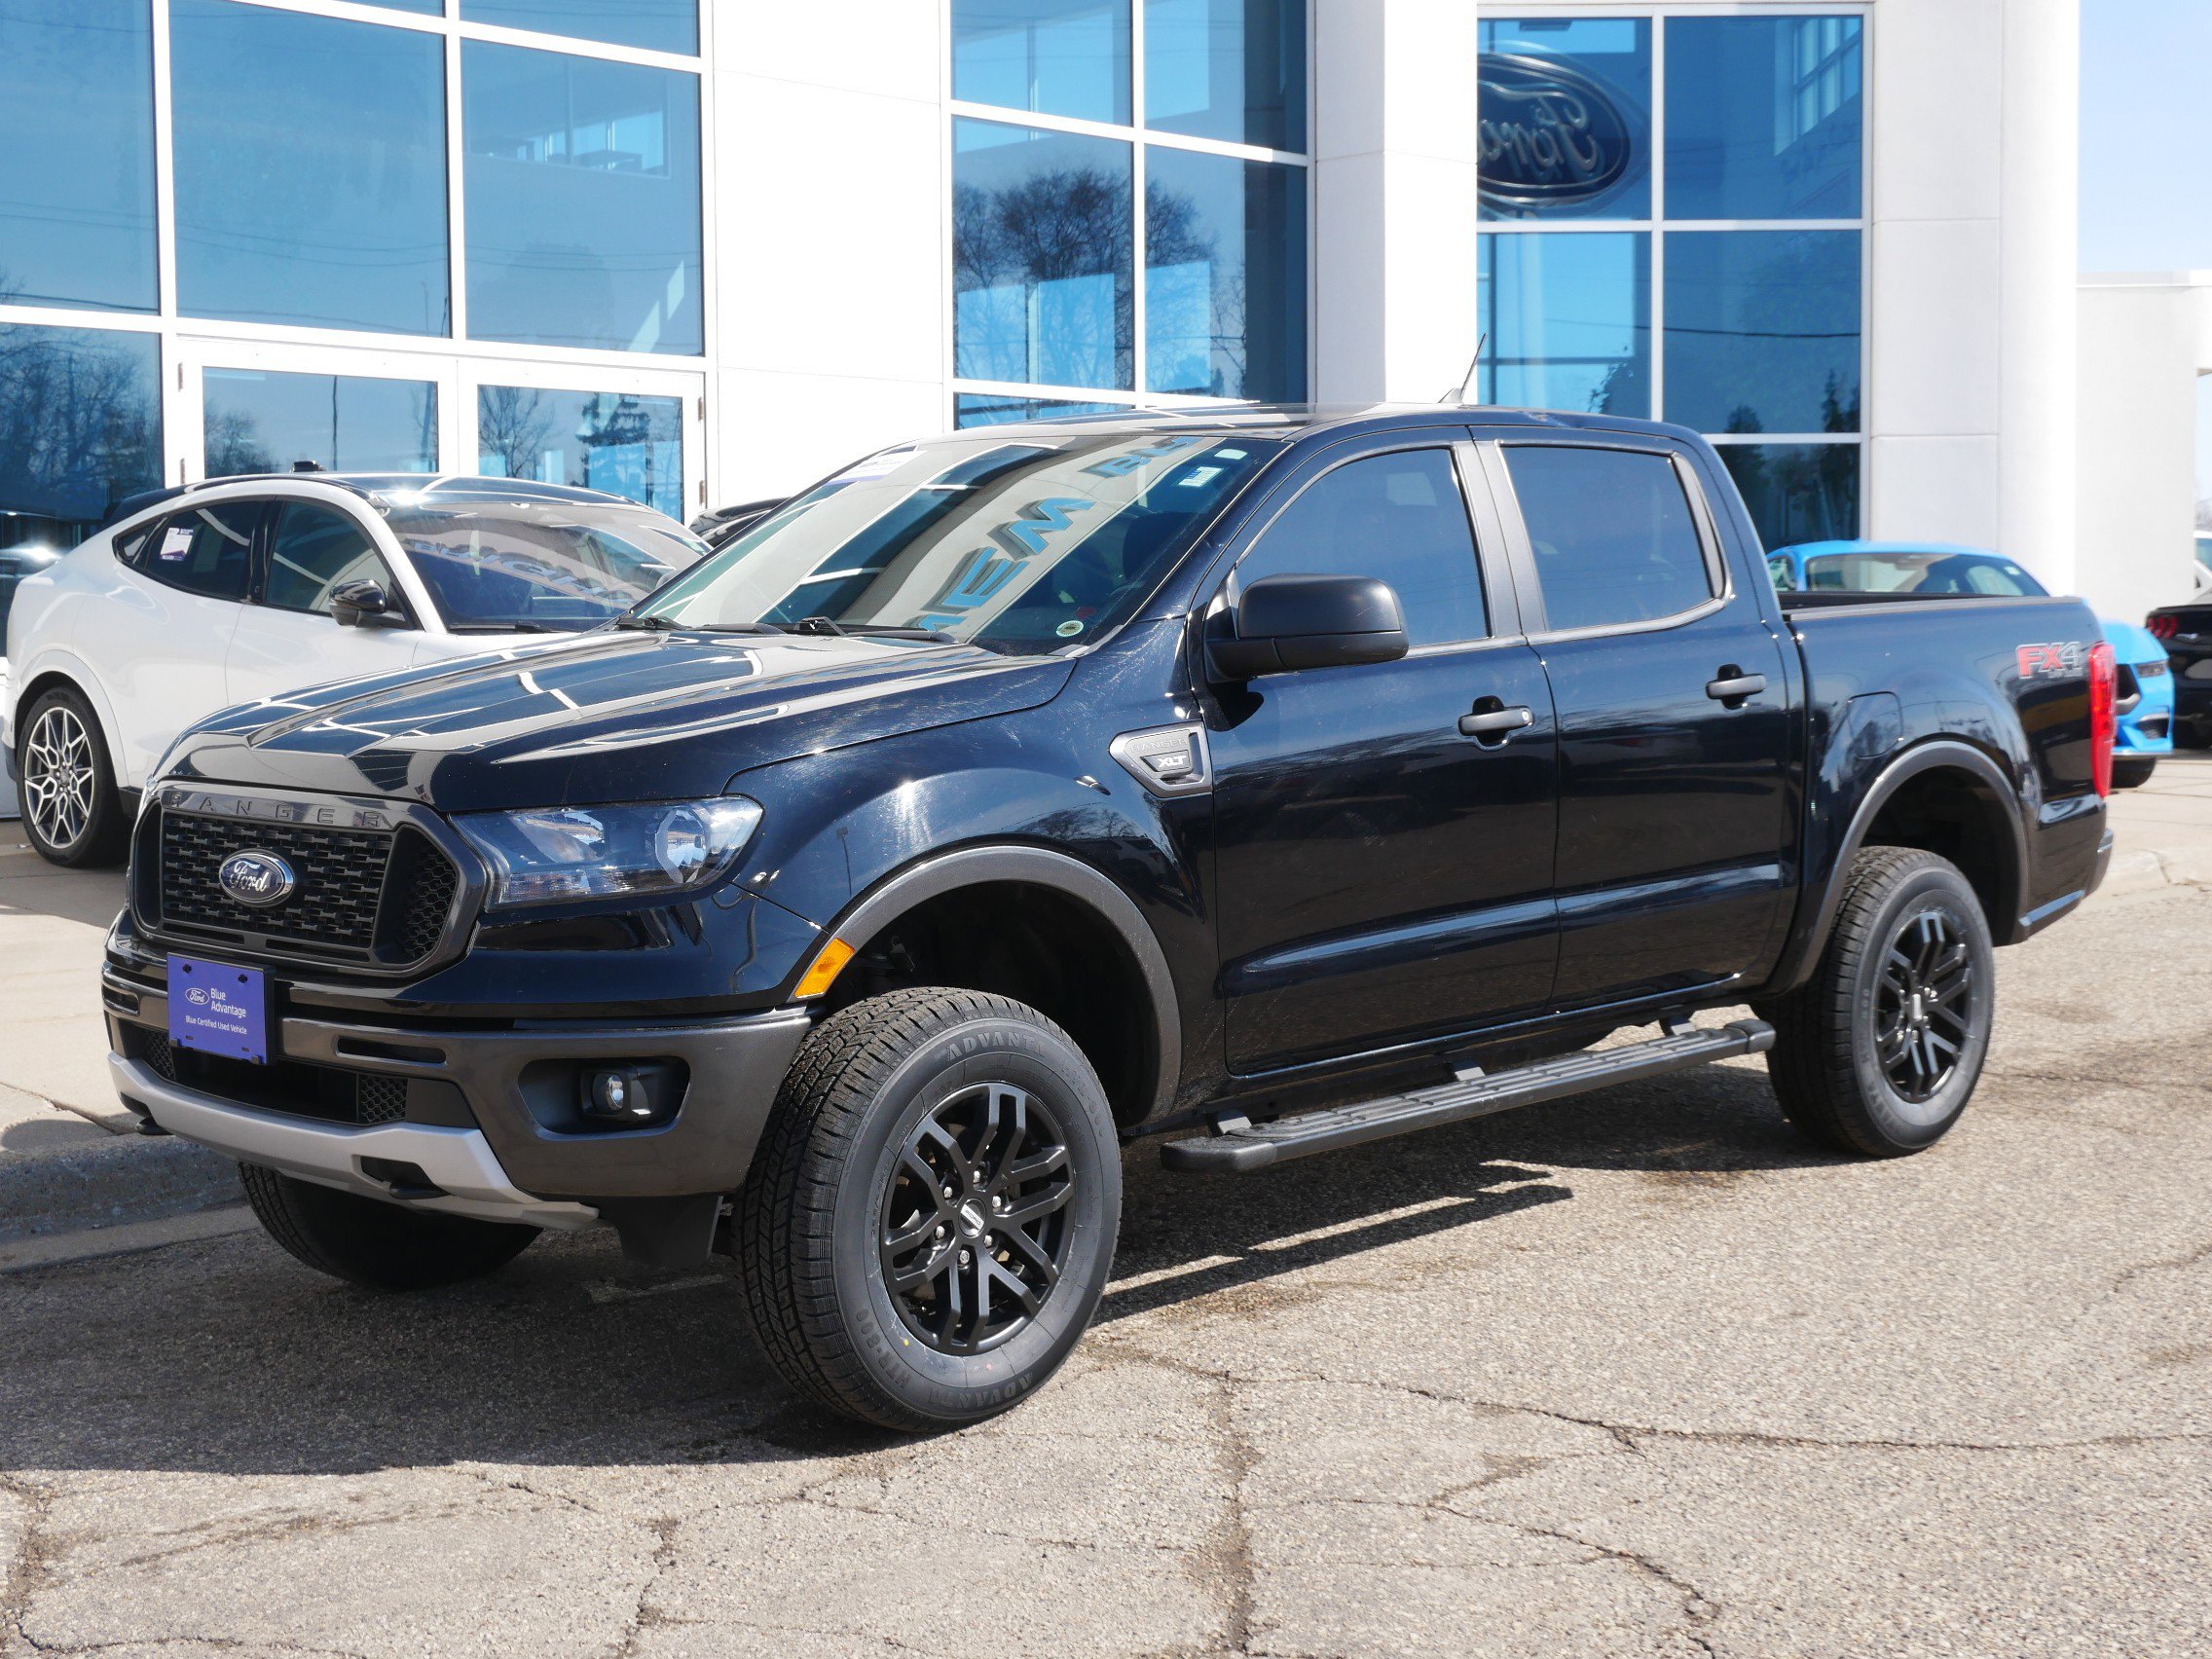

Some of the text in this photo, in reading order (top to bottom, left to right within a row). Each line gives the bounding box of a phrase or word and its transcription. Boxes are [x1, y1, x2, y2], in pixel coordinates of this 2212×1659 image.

[2015, 642, 2082, 680] FX4
[1130, 738, 1188, 753] RANGER
[1158, 755, 1188, 768] XLT
[168, 791, 381, 828] RANGER
[229, 859, 268, 893] Ford
[210, 987, 227, 1001] Blue
[210, 1000, 247, 1018] Advantage
[185, 1014, 247, 1035] Blue Certified Used Vehicle
